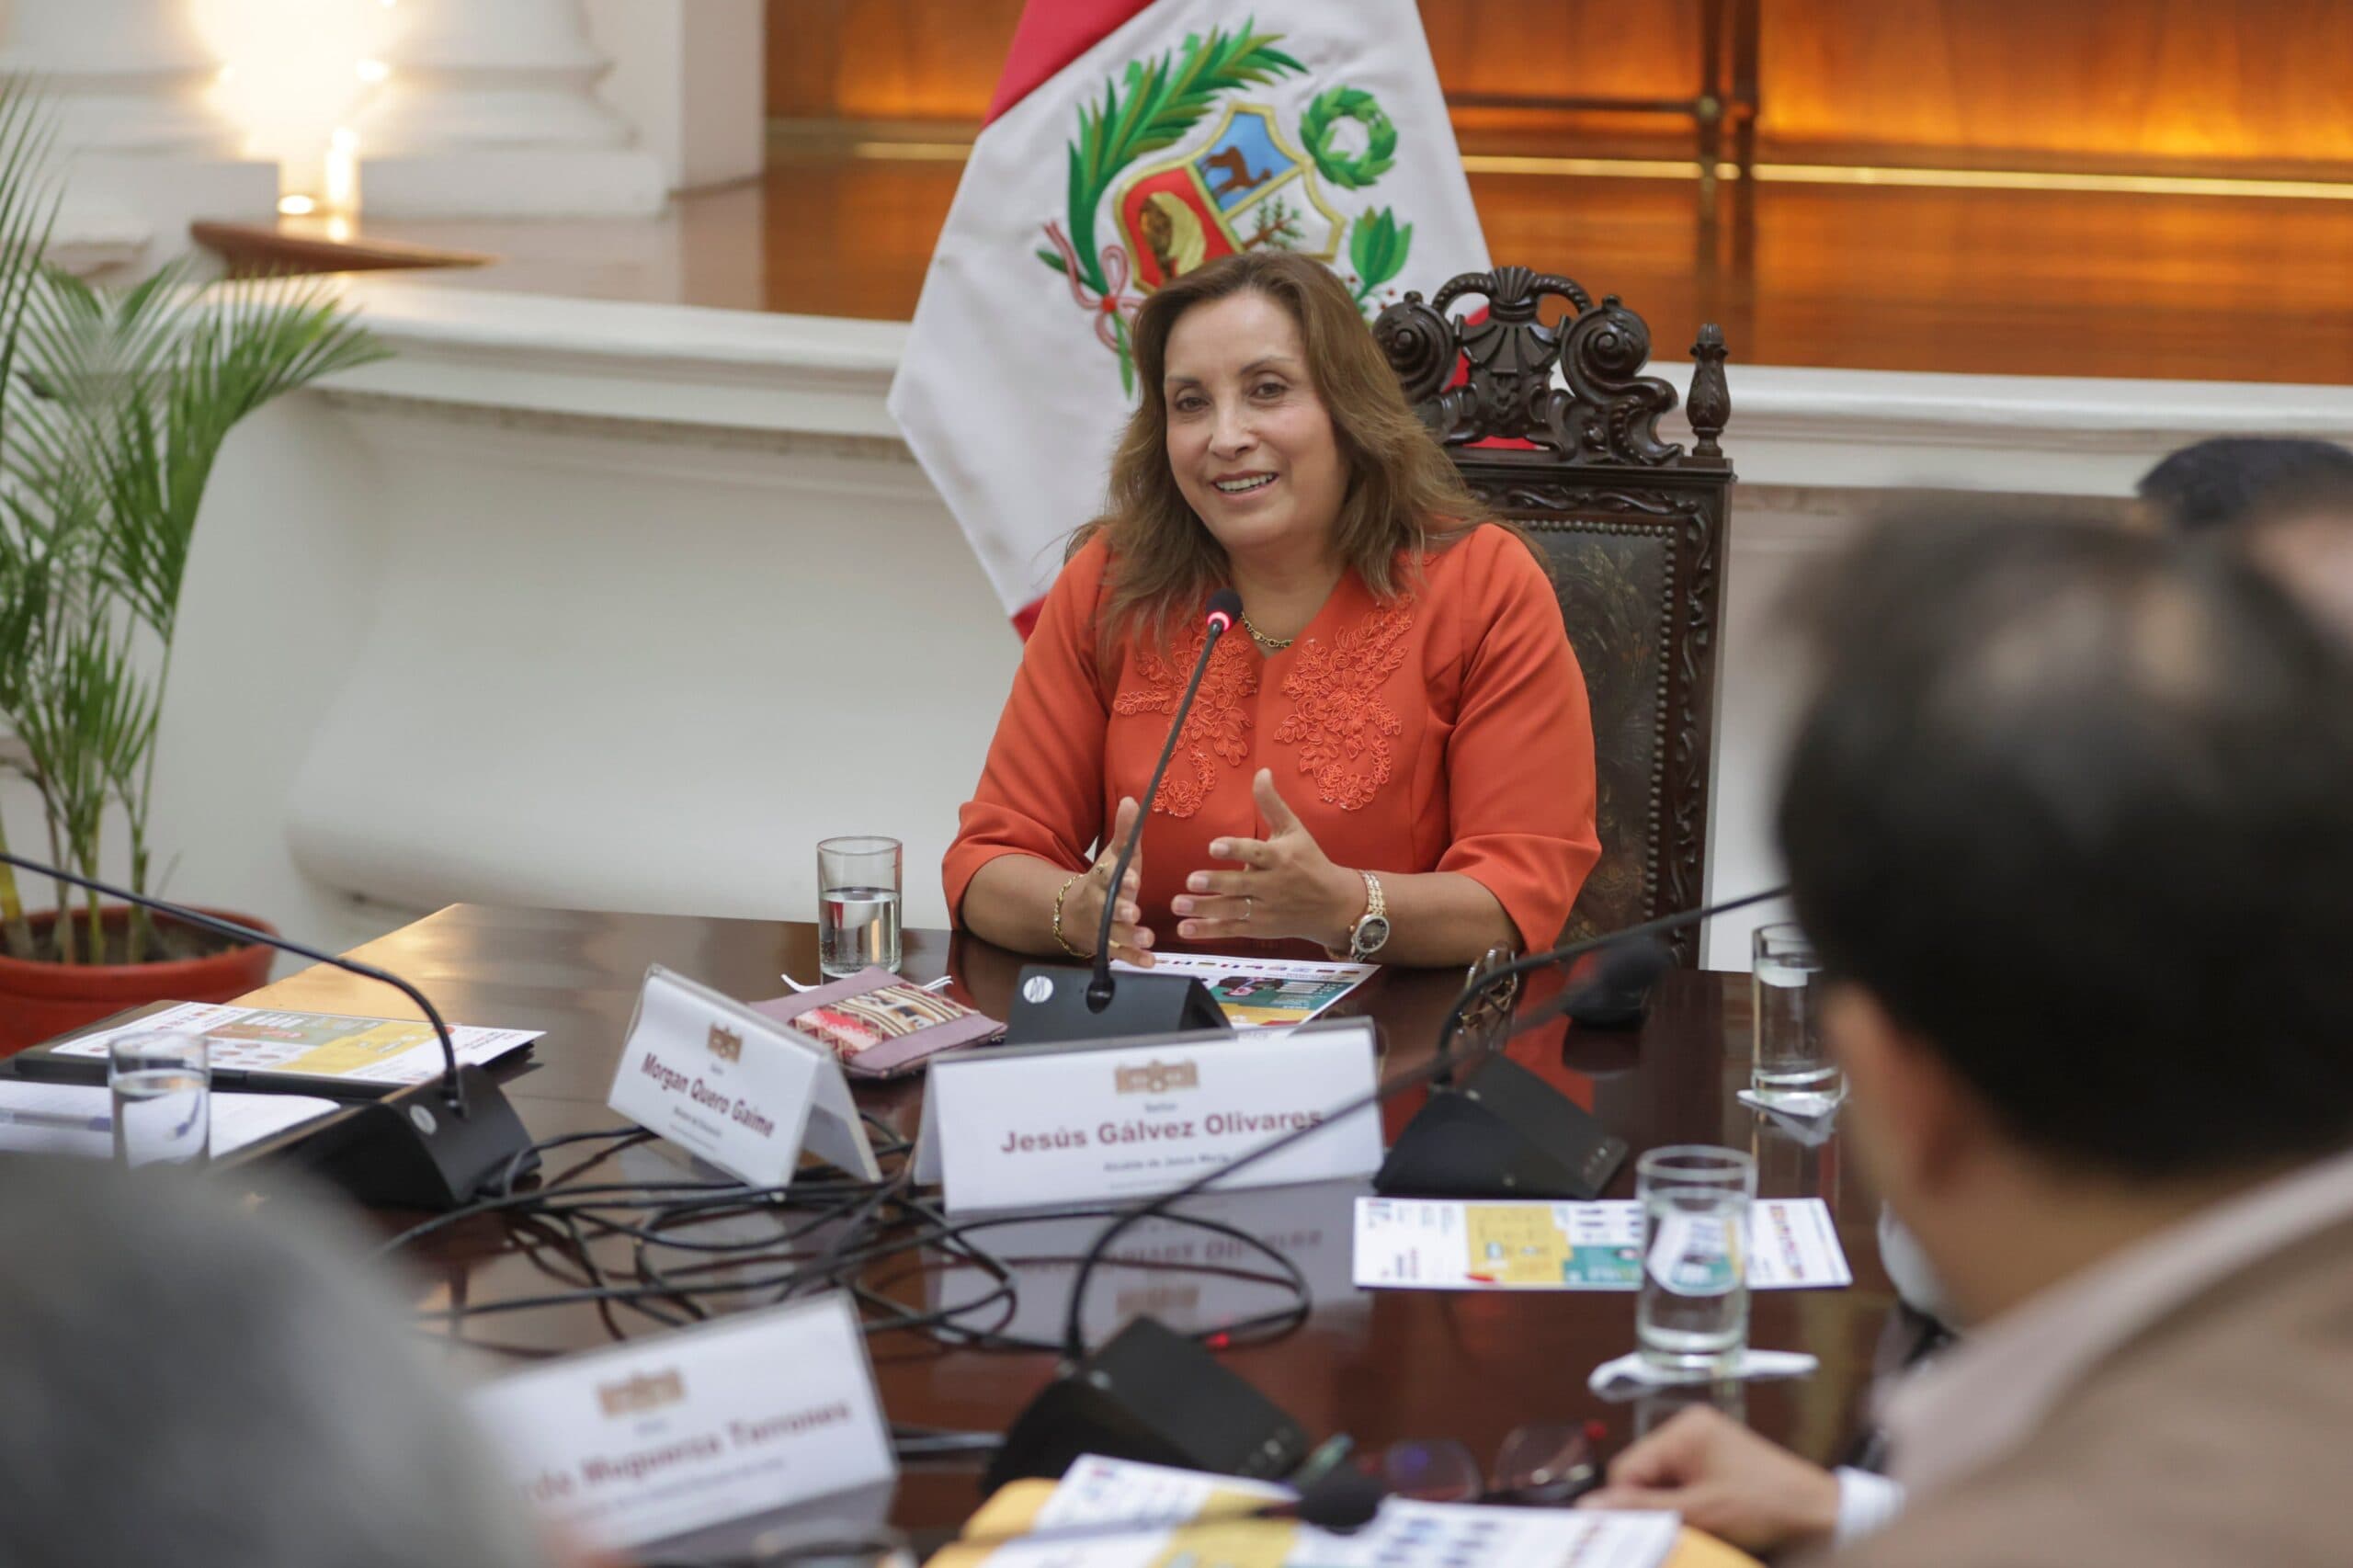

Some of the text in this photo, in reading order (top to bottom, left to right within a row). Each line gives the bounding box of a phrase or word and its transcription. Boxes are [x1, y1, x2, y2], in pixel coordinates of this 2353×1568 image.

[642, 1052, 688, 1092] Morgan
[690, 1077, 730, 1114] Quero
[1001, 1109, 1324, 1153] Jesús Gálvez Olivares
